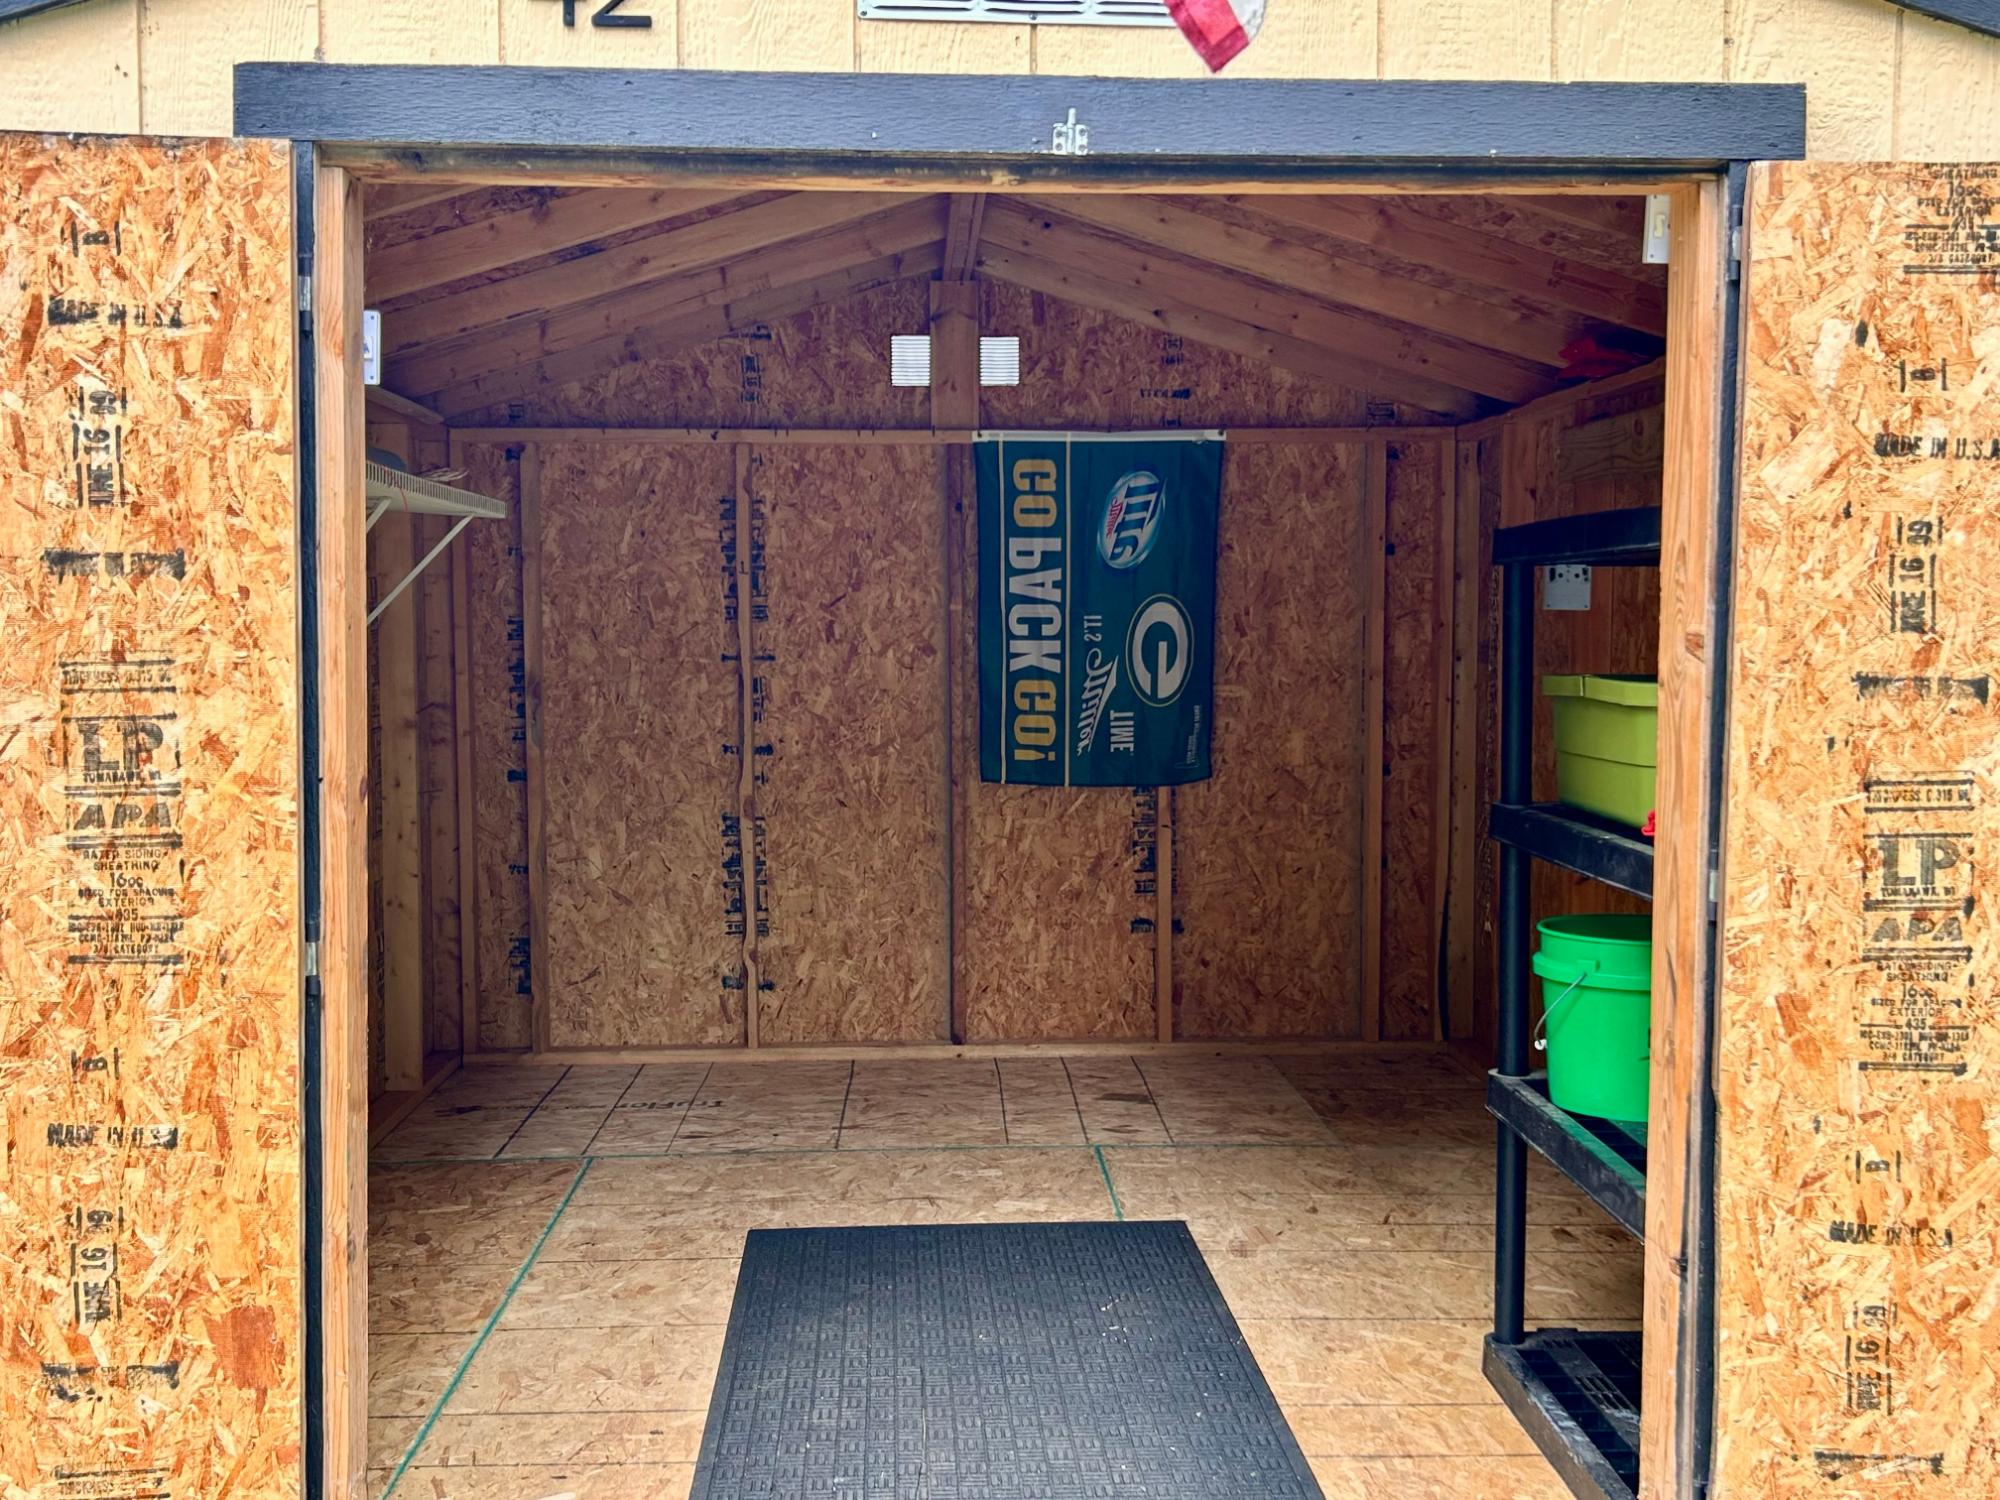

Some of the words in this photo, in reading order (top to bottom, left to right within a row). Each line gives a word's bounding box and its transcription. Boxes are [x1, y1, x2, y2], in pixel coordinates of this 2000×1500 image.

[108, 302, 127, 325] IN
[83, 428, 109, 455] 16
[1930, 437, 1948, 459] IN
[1898, 558, 1925, 583] 16
[78, 721, 164, 771] LP
[73, 803, 171, 830] APA
[94, 860, 160, 872] SHEATHING
[1878, 838, 1961, 886] LP
[98, 897, 155, 907] EXTERIOR
[1871, 917, 1963, 942] APA
[1889, 1007, 1943, 1017] EXTERIOR
[1905, 1018, 1926, 1030] 435
[47, 1122, 99, 1148] MADE
[108, 1126, 124, 1149] IN
[1829, 1219, 1877, 1245] MADE
[1886, 1226, 1902, 1246] IN
[80, 1247, 107, 1272] 16
[1854, 1339, 1879, 1364] 16
